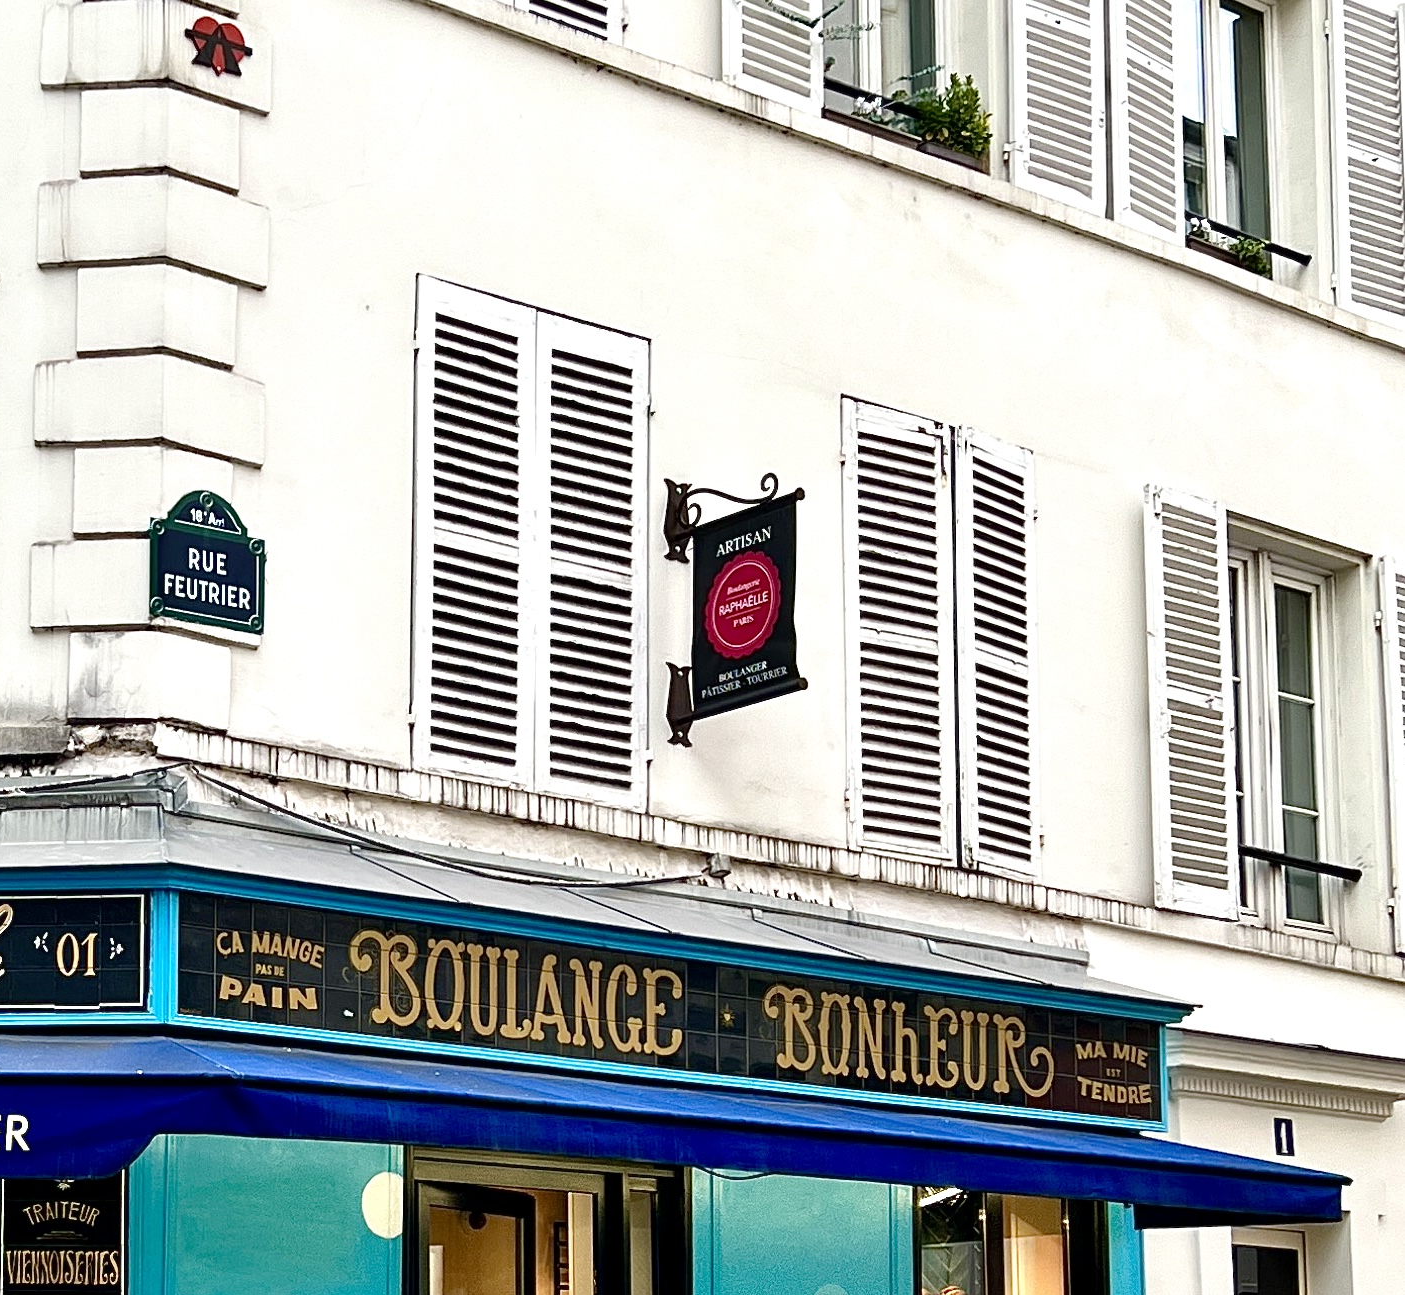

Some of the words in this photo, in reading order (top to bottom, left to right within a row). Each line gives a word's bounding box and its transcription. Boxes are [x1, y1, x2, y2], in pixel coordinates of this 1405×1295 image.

[716, 526, 772, 557] ARTISAN
[188, 547, 227, 575] RUE
[164, 573, 250, 610] FEUTRIER
[719, 590, 768, 616] RAPHAËLLE
[733, 615, 754, 627] PARIS
[701, 680, 742, 699] PÂTISSIER
[746, 666, 788, 685] TOURRIER
[719, 661, 767, 682] BOULANGER
[56, 934, 98, 978] 01
[216, 930, 245, 959] ÇA
[252, 930, 325, 969] MANGE
[255, 963, 273, 976] PAS
[274, 965, 285, 977] DE
[219, 975, 318, 1010] PAIN
[348, 929, 684, 1056] BOULANGE
[1075, 1041, 1108, 1060] MA
[1113, 1042, 1149, 1069] MIE
[1106, 1068, 1122, 1078] EST
[1076, 1075, 1152, 1104] TENDRE
[1280, 1122, 1289, 1154] 1
[23, 1201, 100, 1226] TRAITEUR
[6, 1250, 119, 1285] VIENNOISERIES
